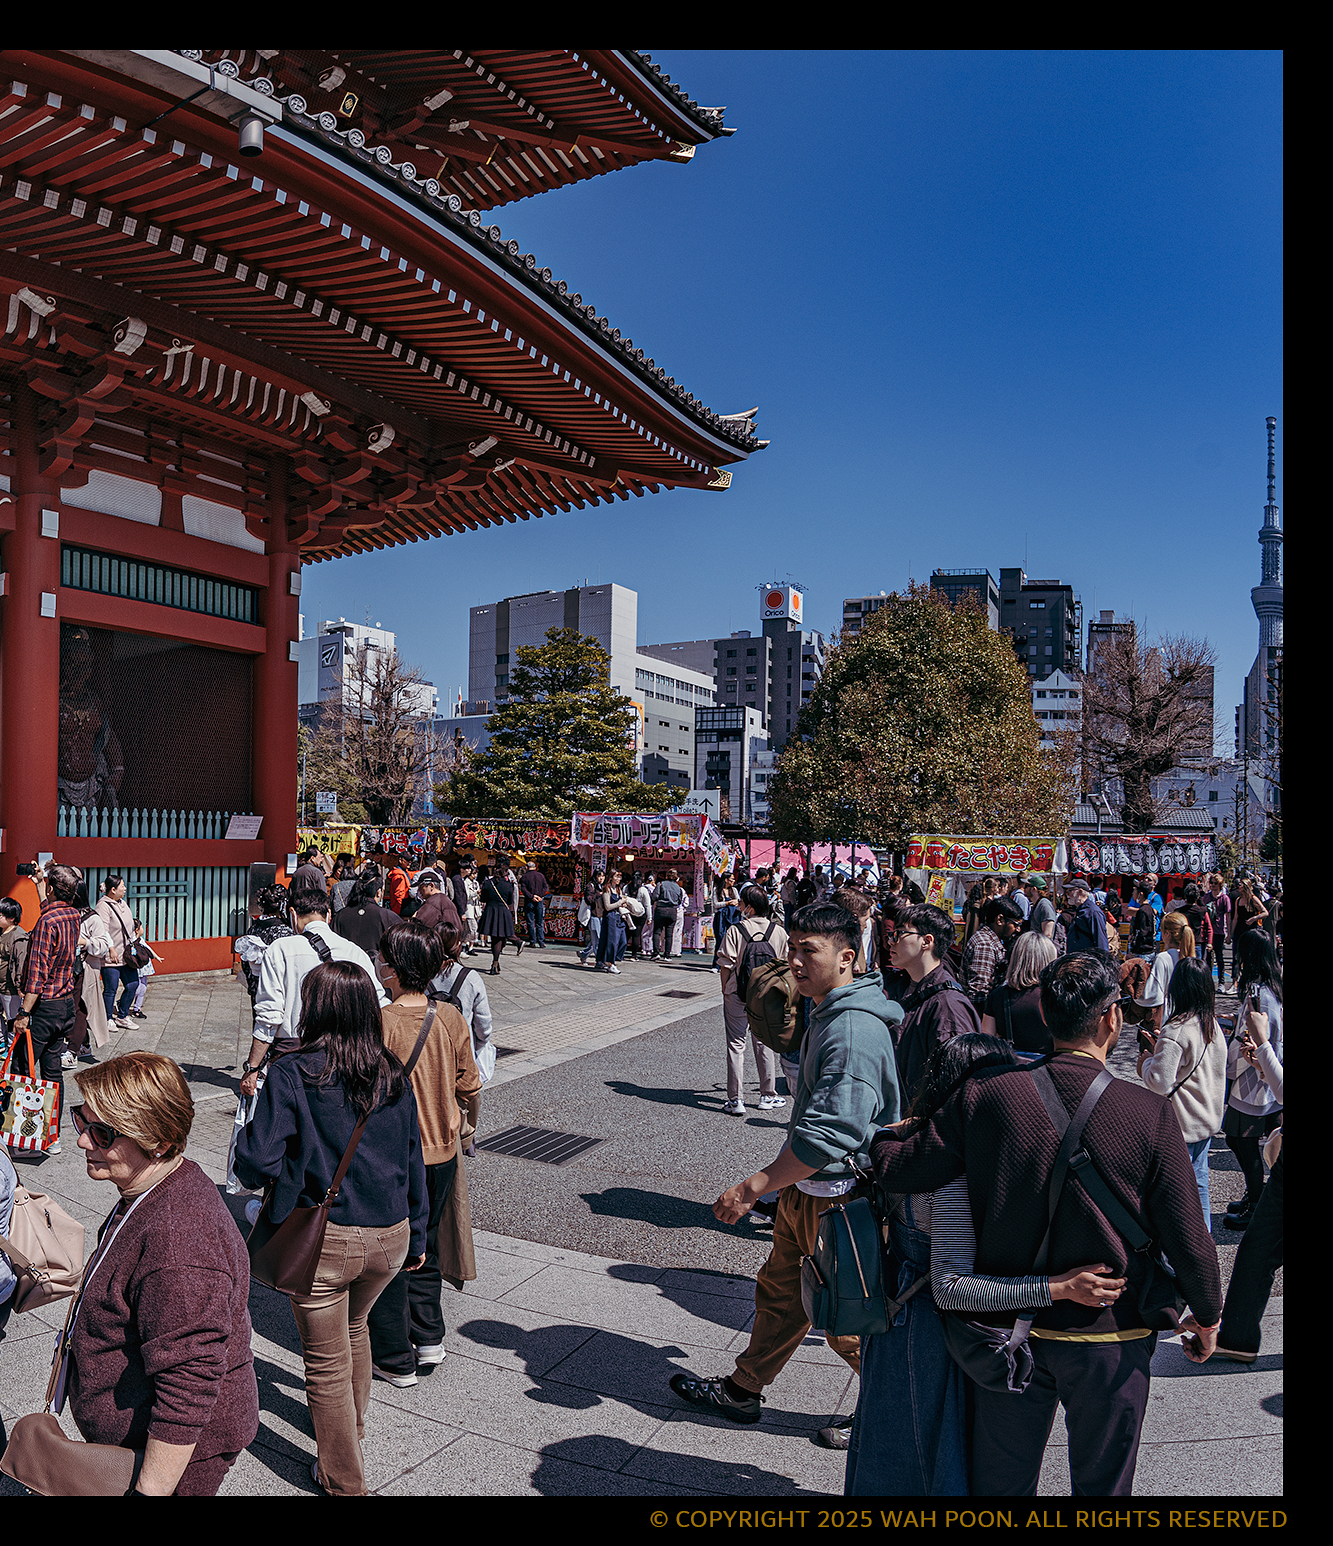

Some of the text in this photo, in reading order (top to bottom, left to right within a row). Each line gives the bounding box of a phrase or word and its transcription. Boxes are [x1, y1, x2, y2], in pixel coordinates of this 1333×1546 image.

[948, 844, 1031, 871] たこやき
[1101, 843, 1217, 874] 肉巻きもちもち棒
